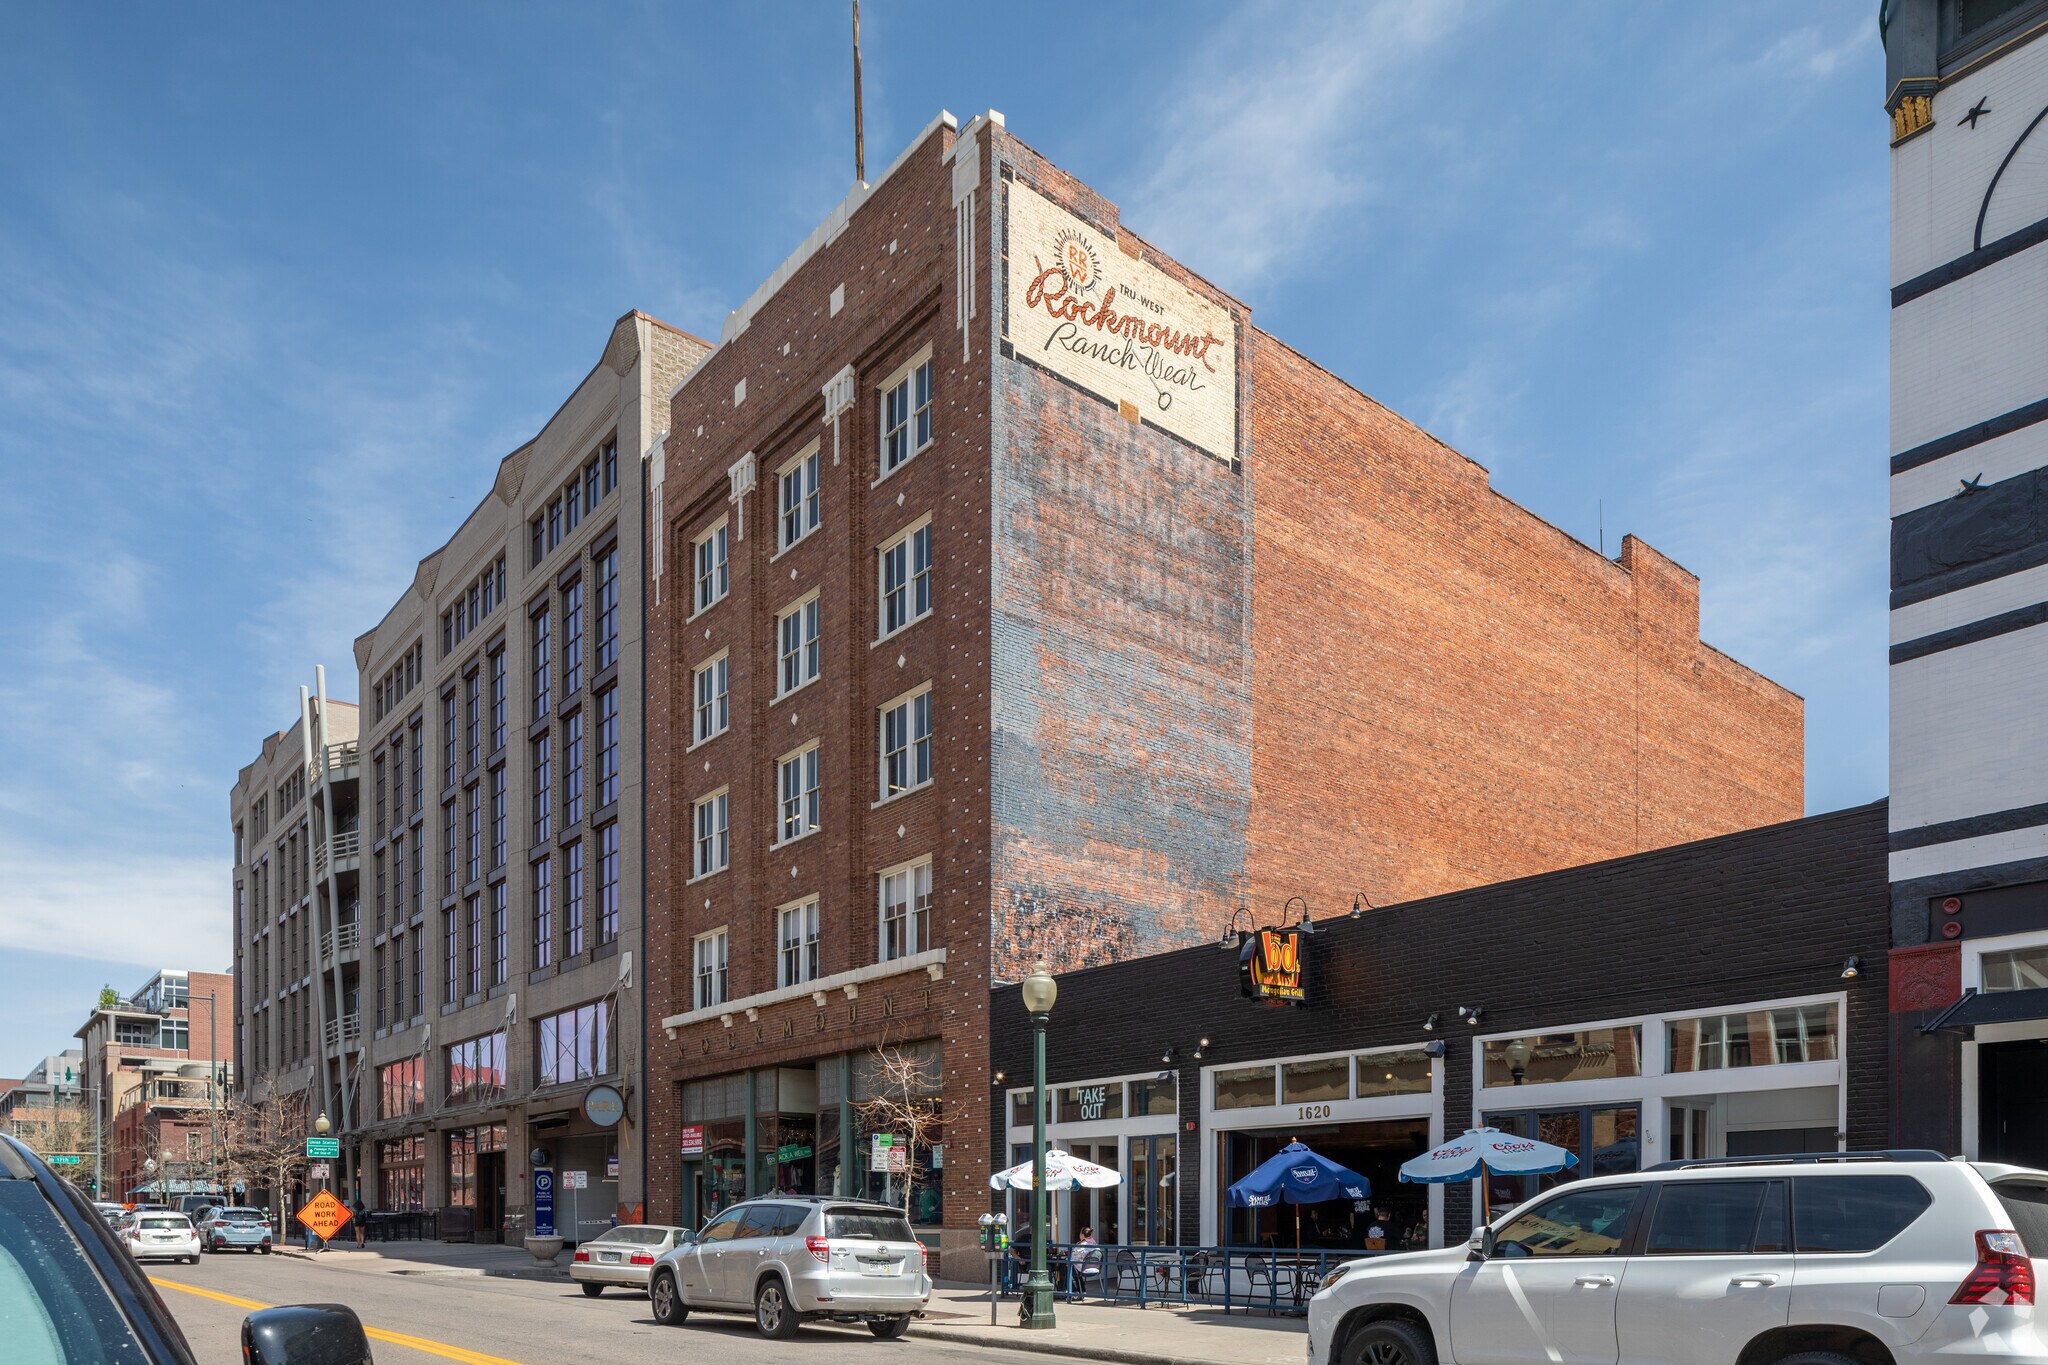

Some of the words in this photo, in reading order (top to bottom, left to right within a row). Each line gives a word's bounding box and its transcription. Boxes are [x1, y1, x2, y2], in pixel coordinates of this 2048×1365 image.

[1119, 283, 1165, 315] TRU-WEST
[1026, 255, 1224, 374] Rockmount
[1044, 322, 1137, 370] Ranch
[1140, 345, 1206, 391] Wear
[1291, 988, 1303, 997] Grill
[677, 989, 931, 1058] ROCKMOUNT
[1078, 1087, 1106, 1104] TAKE
[1081, 1103, 1103, 1120] OUT
[1298, 1105, 1330, 1120] 1620
[1491, 1142, 1535, 1150] Coors
[541, 1178, 549, 1187] P
[1249, 1194, 1271, 1203] SAMUEL
